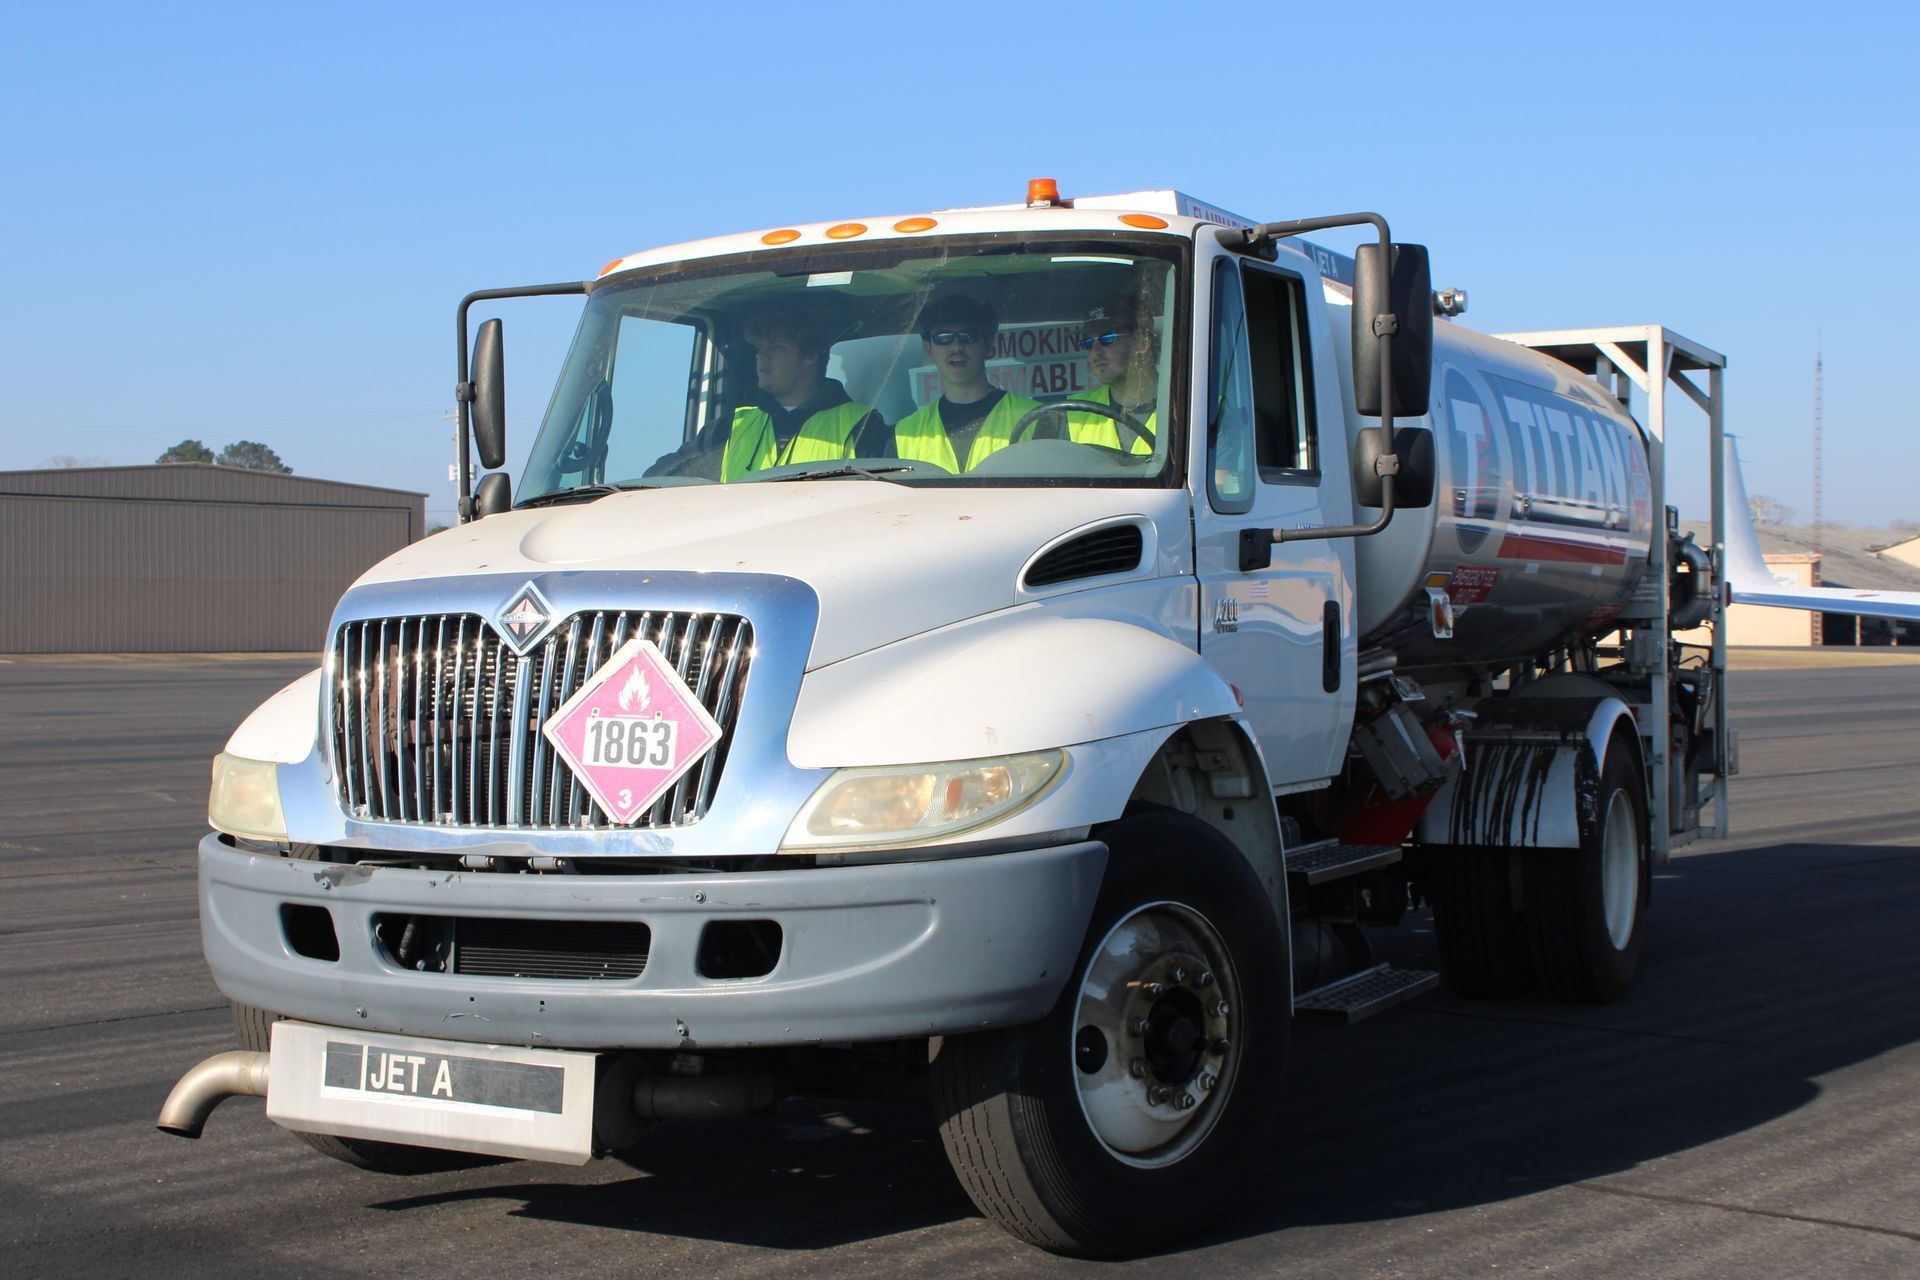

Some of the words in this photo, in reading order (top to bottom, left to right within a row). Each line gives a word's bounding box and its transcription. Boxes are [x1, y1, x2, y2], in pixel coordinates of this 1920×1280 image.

[1192, 205, 1248, 229] FLAMMABL
[1502, 395, 1629, 511] TITAN
[591, 720, 671, 766] 1863
[618, 789, 632, 809] 3
[370, 1053, 426, 1093] JET
[431, 1060, 453, 1097] A
